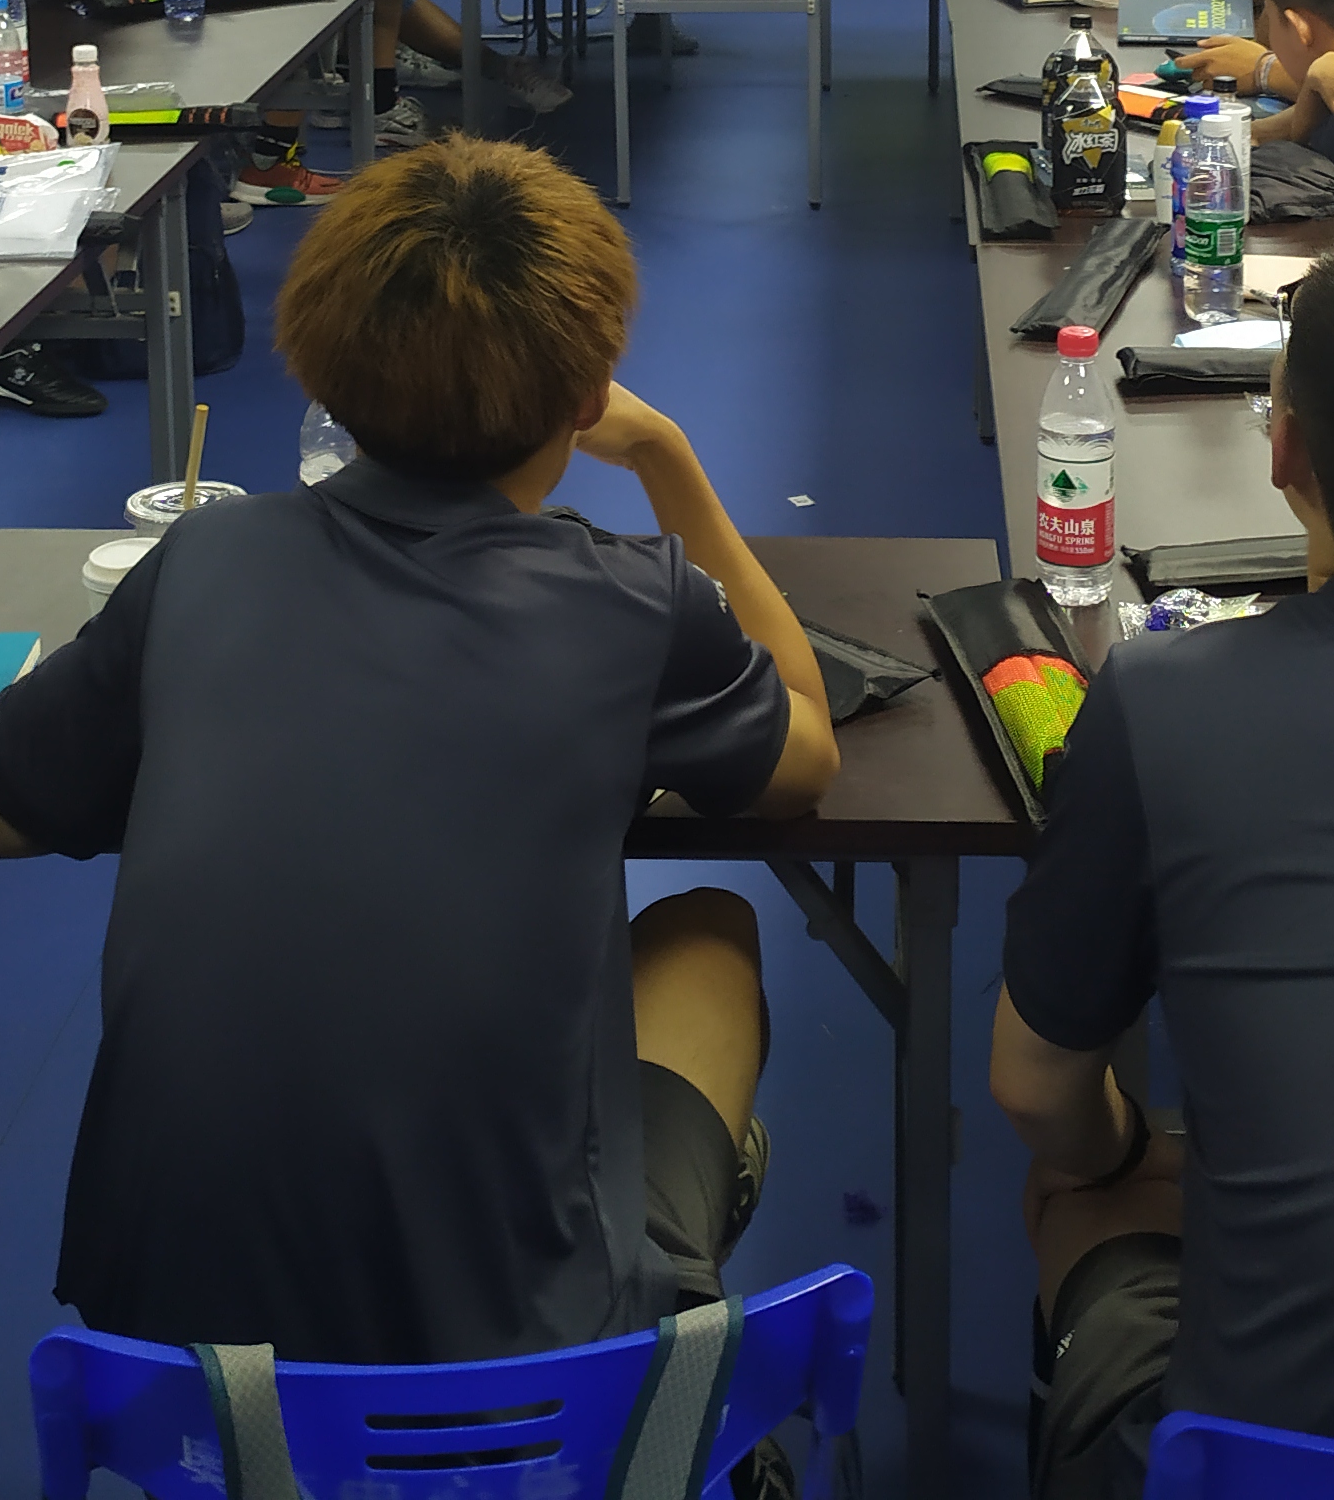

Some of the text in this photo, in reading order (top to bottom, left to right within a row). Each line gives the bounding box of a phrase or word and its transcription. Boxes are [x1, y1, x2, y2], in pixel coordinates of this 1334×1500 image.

[1038, 512, 1095, 536] 农夫山泉
[1065, 536, 1095, 545] SPRING
